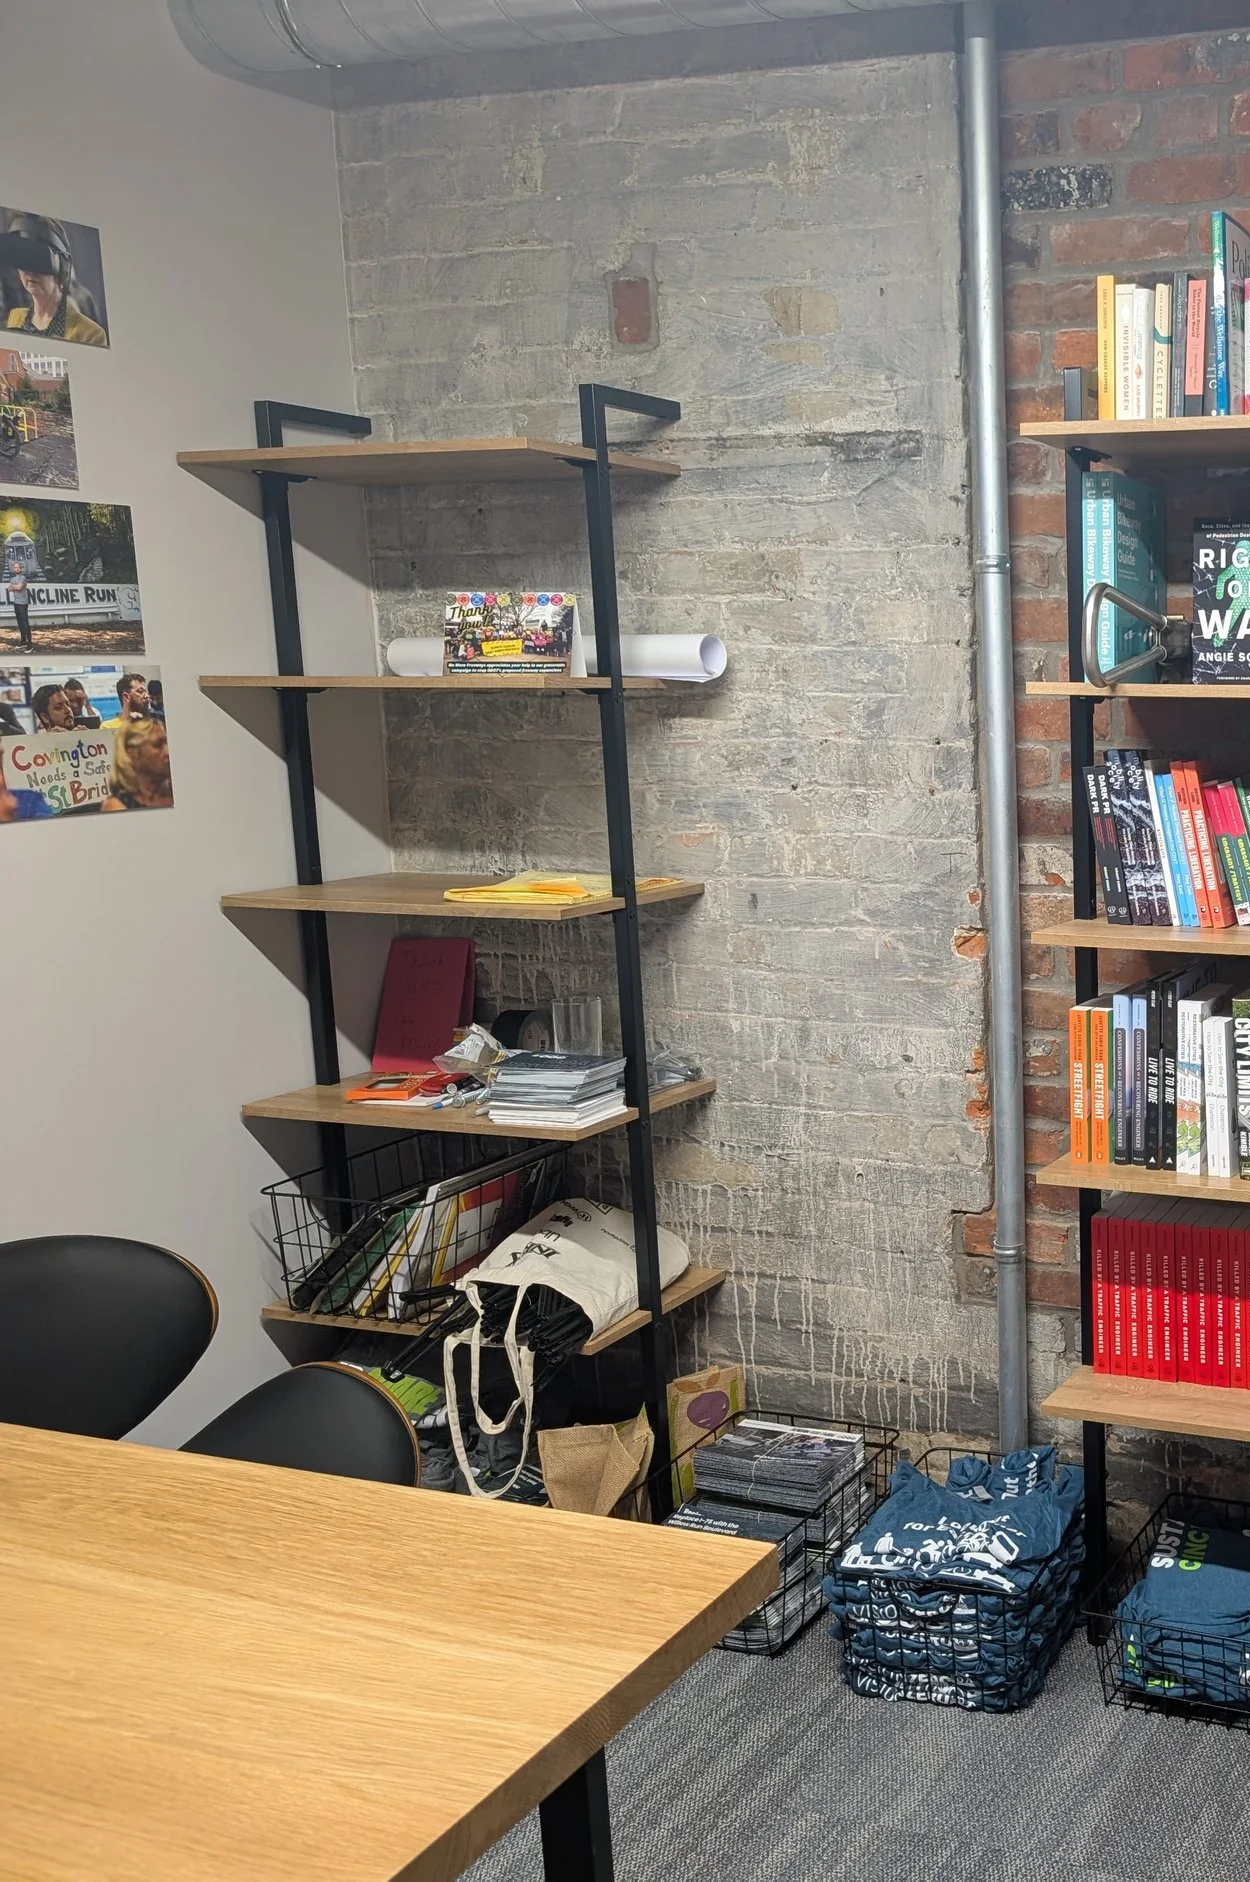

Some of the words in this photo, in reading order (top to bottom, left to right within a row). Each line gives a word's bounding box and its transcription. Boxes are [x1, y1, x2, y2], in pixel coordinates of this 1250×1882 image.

[1122, 375, 1130, 411] WOMEN
[1154, 350, 1164, 422] CYCLETTES
[1086, 490, 1096, 526] Urban
[1086, 529, 1097, 578] Bikeway
[23, 588, 80, 605] NCLINE
[449, 606, 492, 620] Thank
[1198, 653, 1234, 662] ANGIE
[12, 739, 108, 770] Covington
[27, 767, 67, 788] Needs
[1087, 774, 1098, 800] DARK
[70, 778, 112, 805] Brid
[1091, 801, 1100, 814] PR
[1148, 1057, 1158, 1075] LIVE
[1074, 1062, 1084, 1120] STREETFIGHT
[1094, 1062, 1105, 1120] STREETFIGHT
[1148, 1087, 1158, 1104] RIDE
[1240, 1131, 1249, 1158] KIMBLE
[668, 1519, 690, 1527] Willow
[690, 1522, 703, 1530] Run
[703, 1524, 739, 1535] Boulevard
[673, 1514, 700, 1523] Replace
